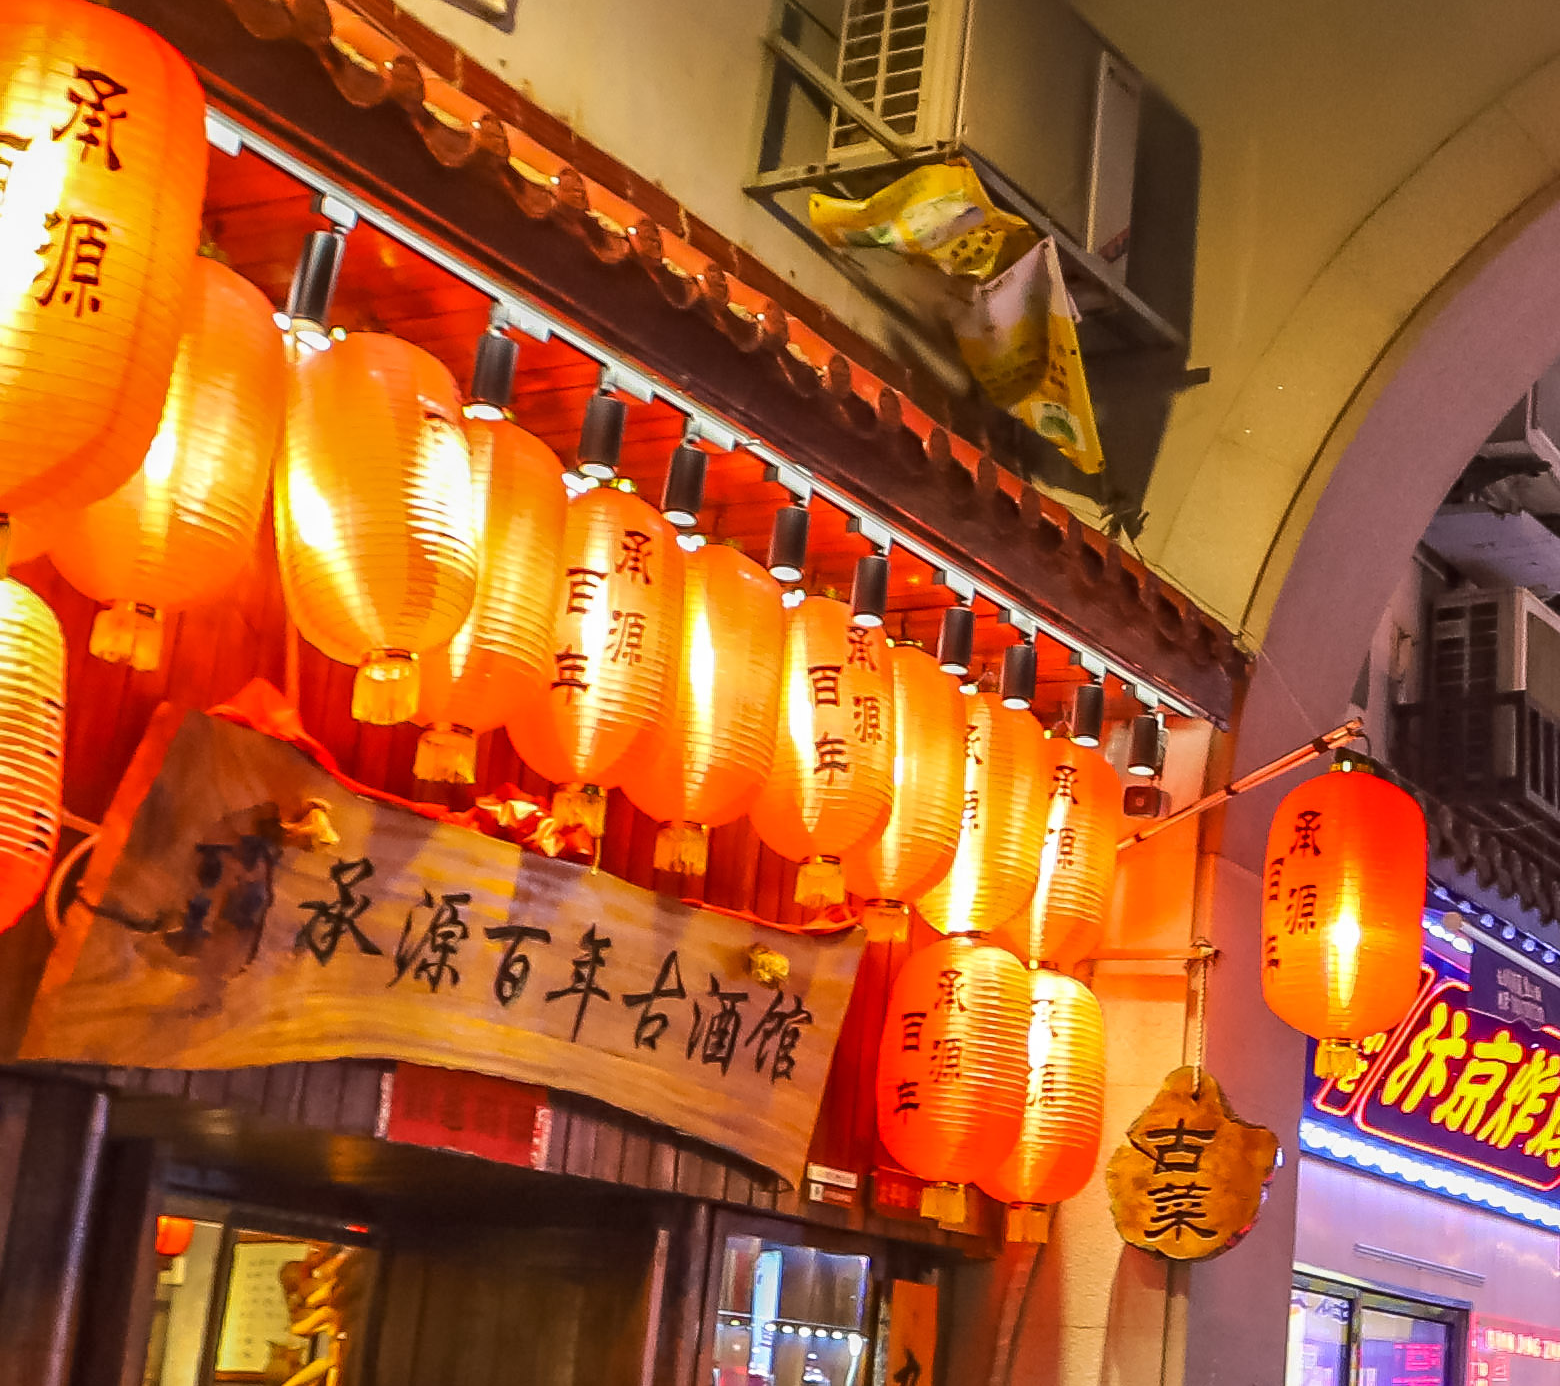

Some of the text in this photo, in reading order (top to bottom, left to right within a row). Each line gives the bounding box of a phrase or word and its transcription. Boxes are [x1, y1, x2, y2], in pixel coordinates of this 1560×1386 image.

[34, 68, 126, 319] 承源
[549, 564, 608, 706] 百年
[598, 528, 656, 669] 承源
[803, 663, 853, 789] 百年
[843, 621, 885, 749] 承源
[295, 855, 816, 1085] 承源百年古酒馆
[1142, 1116, 1220, 1242] 古菜
